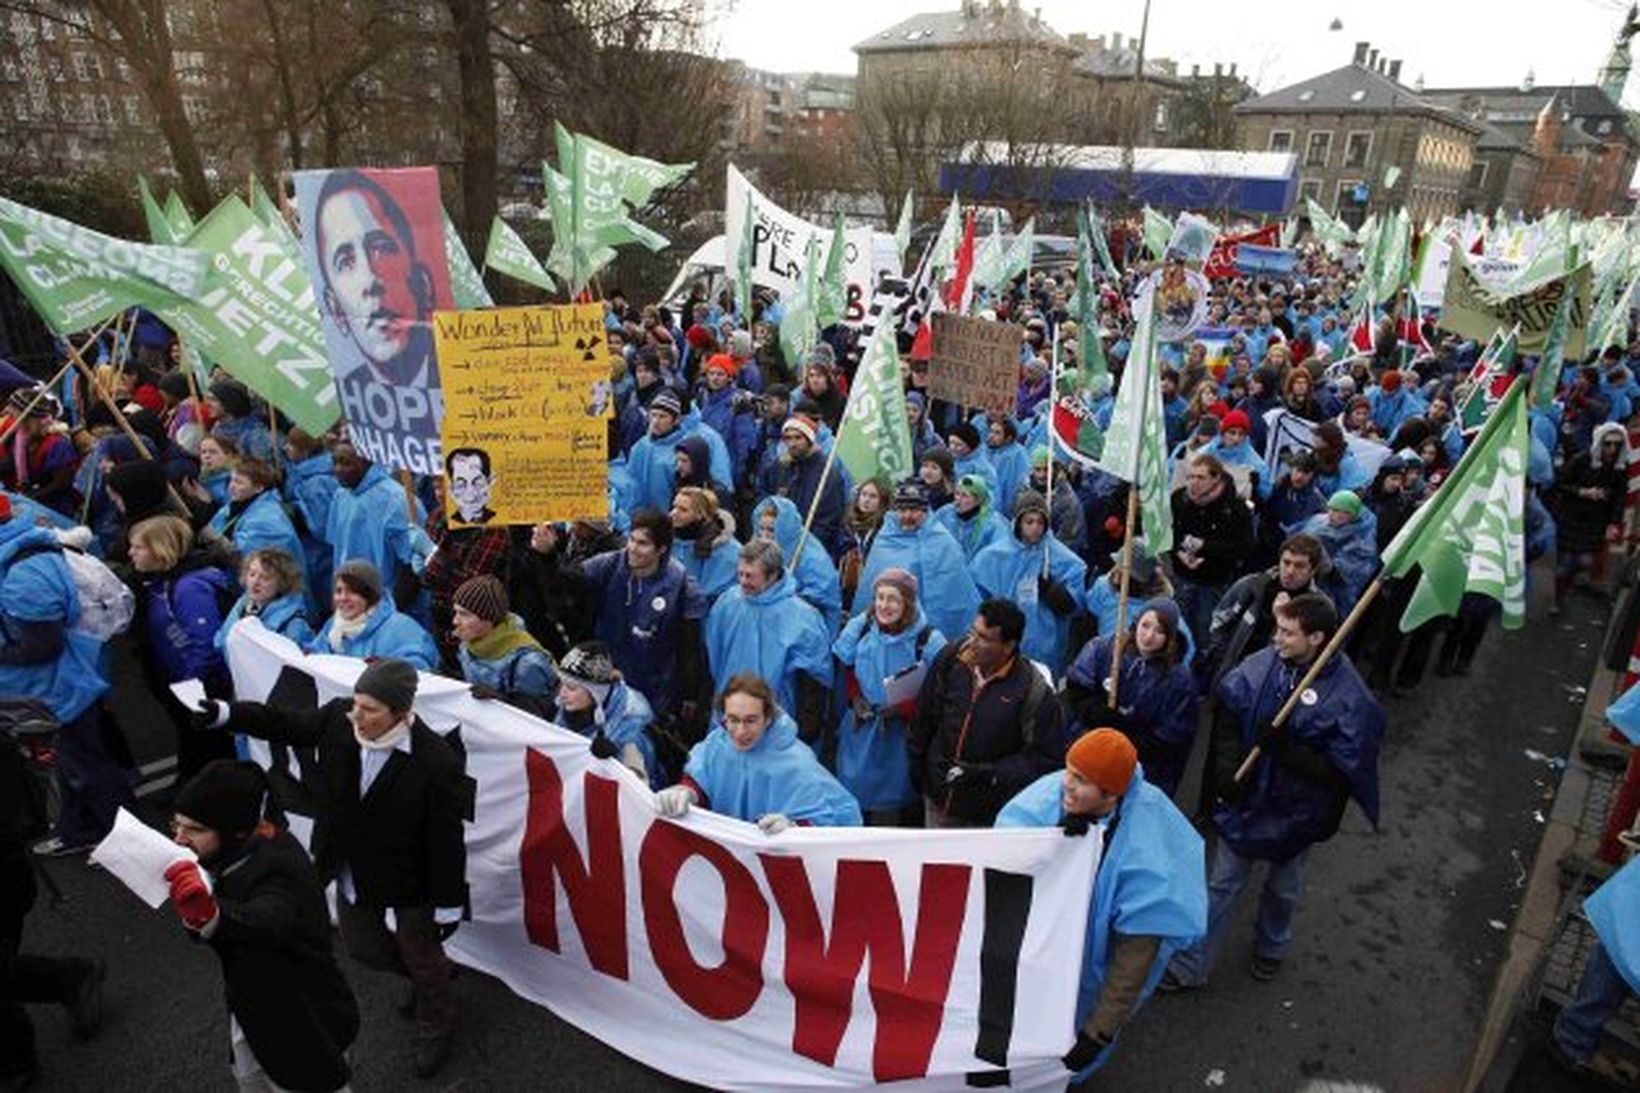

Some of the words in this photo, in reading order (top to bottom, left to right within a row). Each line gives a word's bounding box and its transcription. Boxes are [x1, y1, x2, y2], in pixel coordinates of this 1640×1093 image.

[753, 205, 796, 249] ERE
[845, 284, 865, 322] B
[519, 746, 1034, 1088] NOW!
